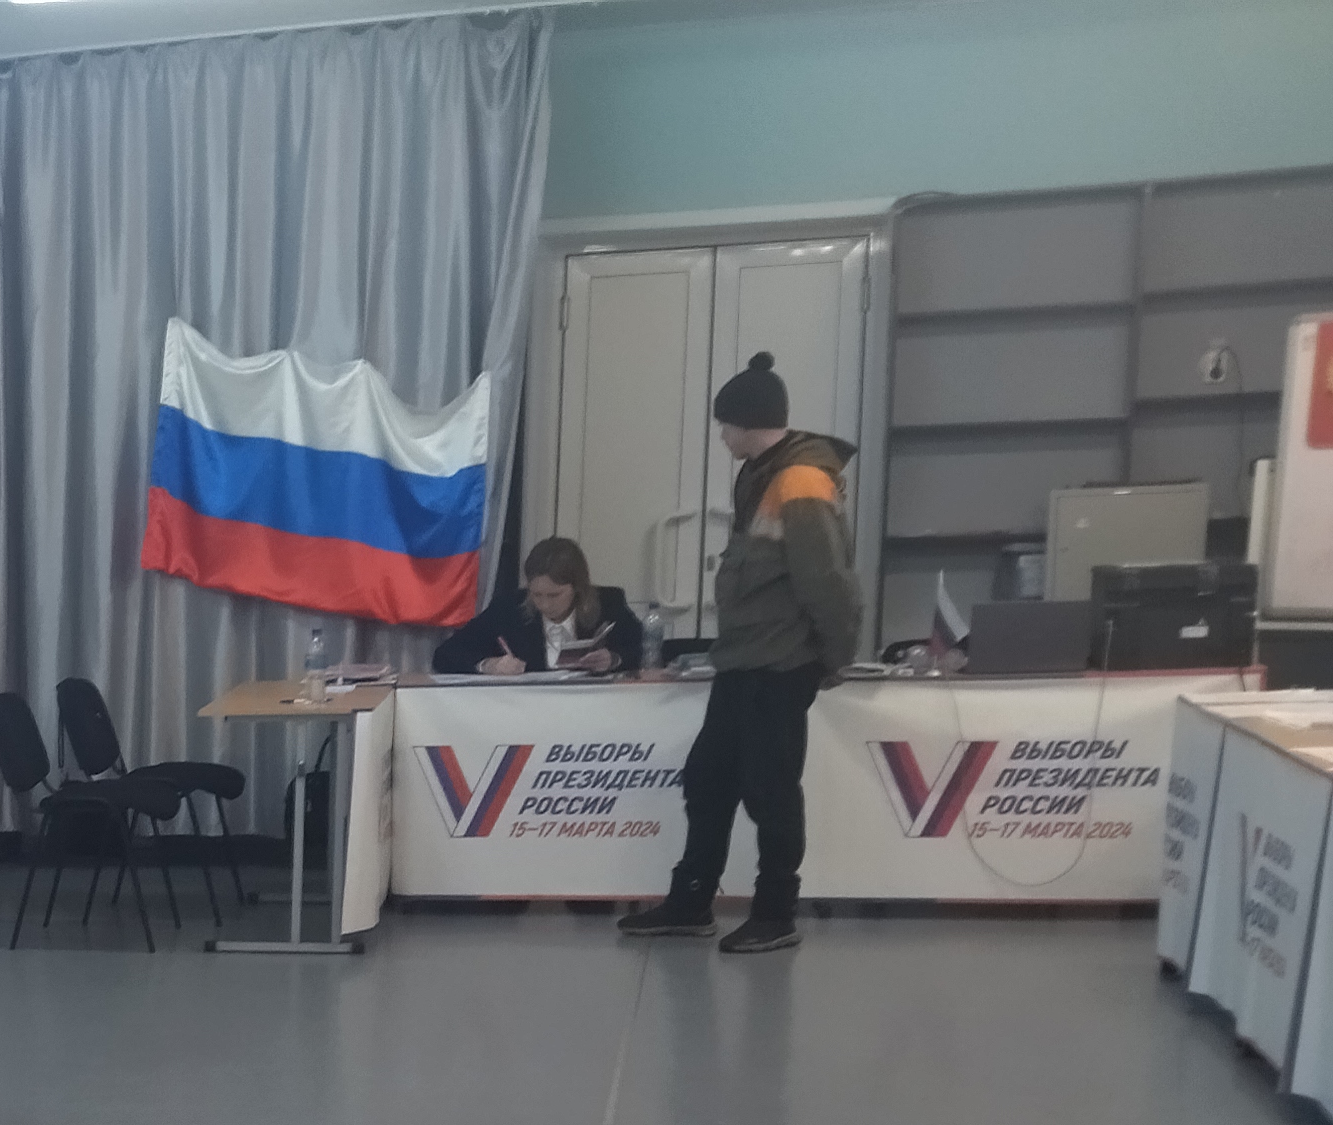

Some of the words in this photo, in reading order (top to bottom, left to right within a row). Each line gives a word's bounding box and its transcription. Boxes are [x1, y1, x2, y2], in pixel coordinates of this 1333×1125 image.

[545, 743, 655, 763] ВЫБОРЫ
[1009, 739, 1130, 761] ВЫБОРЫ
[531, 768, 684, 791] ПРЕЗИДЕНТА
[994, 766, 1161, 790] ПРЕЗИДЕНТА
[518, 795, 618, 815] РОССИИ
[980, 794, 1087, 816] РОССИИ
[558, 821, 616, 838] МАРТА
[617, 821, 662, 838] 2024
[1020, 821, 1084, 839] МАРТА
[1085, 821, 1133, 839] 2024
